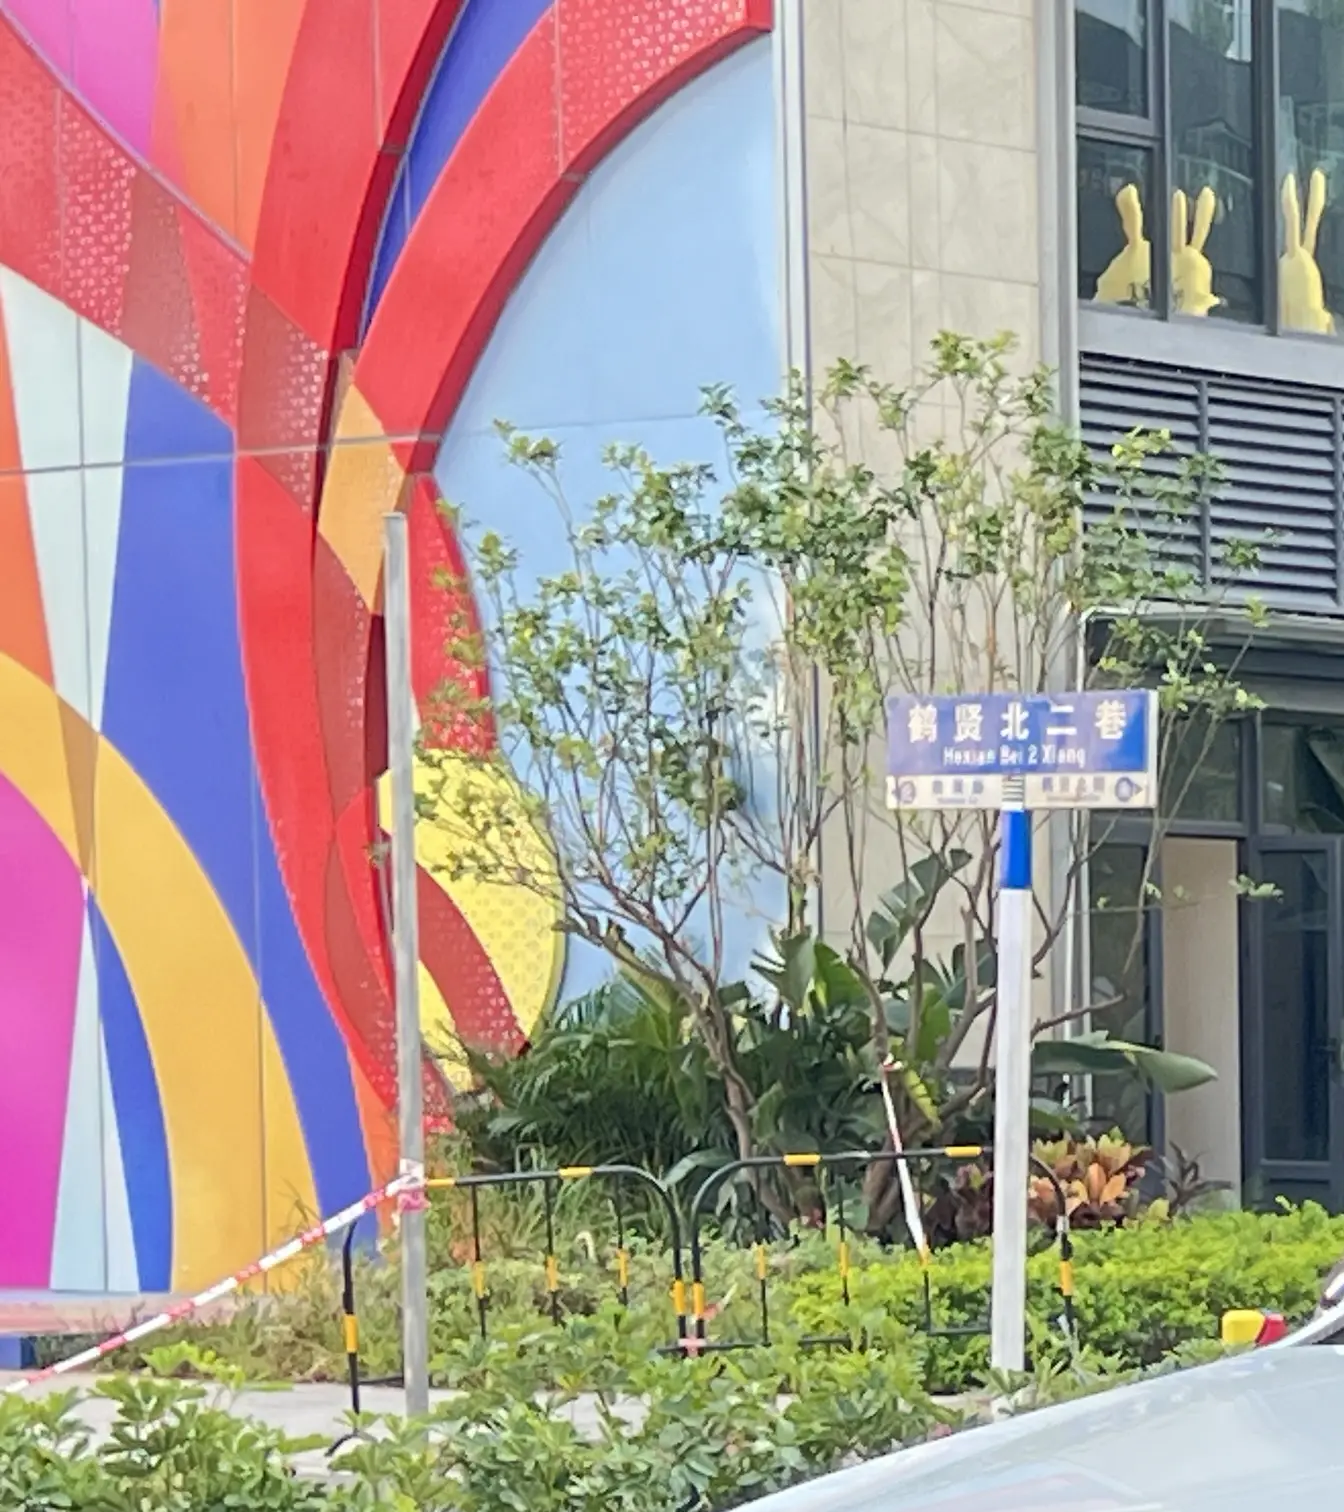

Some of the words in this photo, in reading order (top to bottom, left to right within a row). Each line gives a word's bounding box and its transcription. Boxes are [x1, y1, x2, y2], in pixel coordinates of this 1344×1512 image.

[908, 700, 1127, 743] 鹤贤北二巷
[943, 746, 996, 767] Hexian
[1028, 744, 1038, 765] 2
[1042, 744, 1087, 768] Xiang
